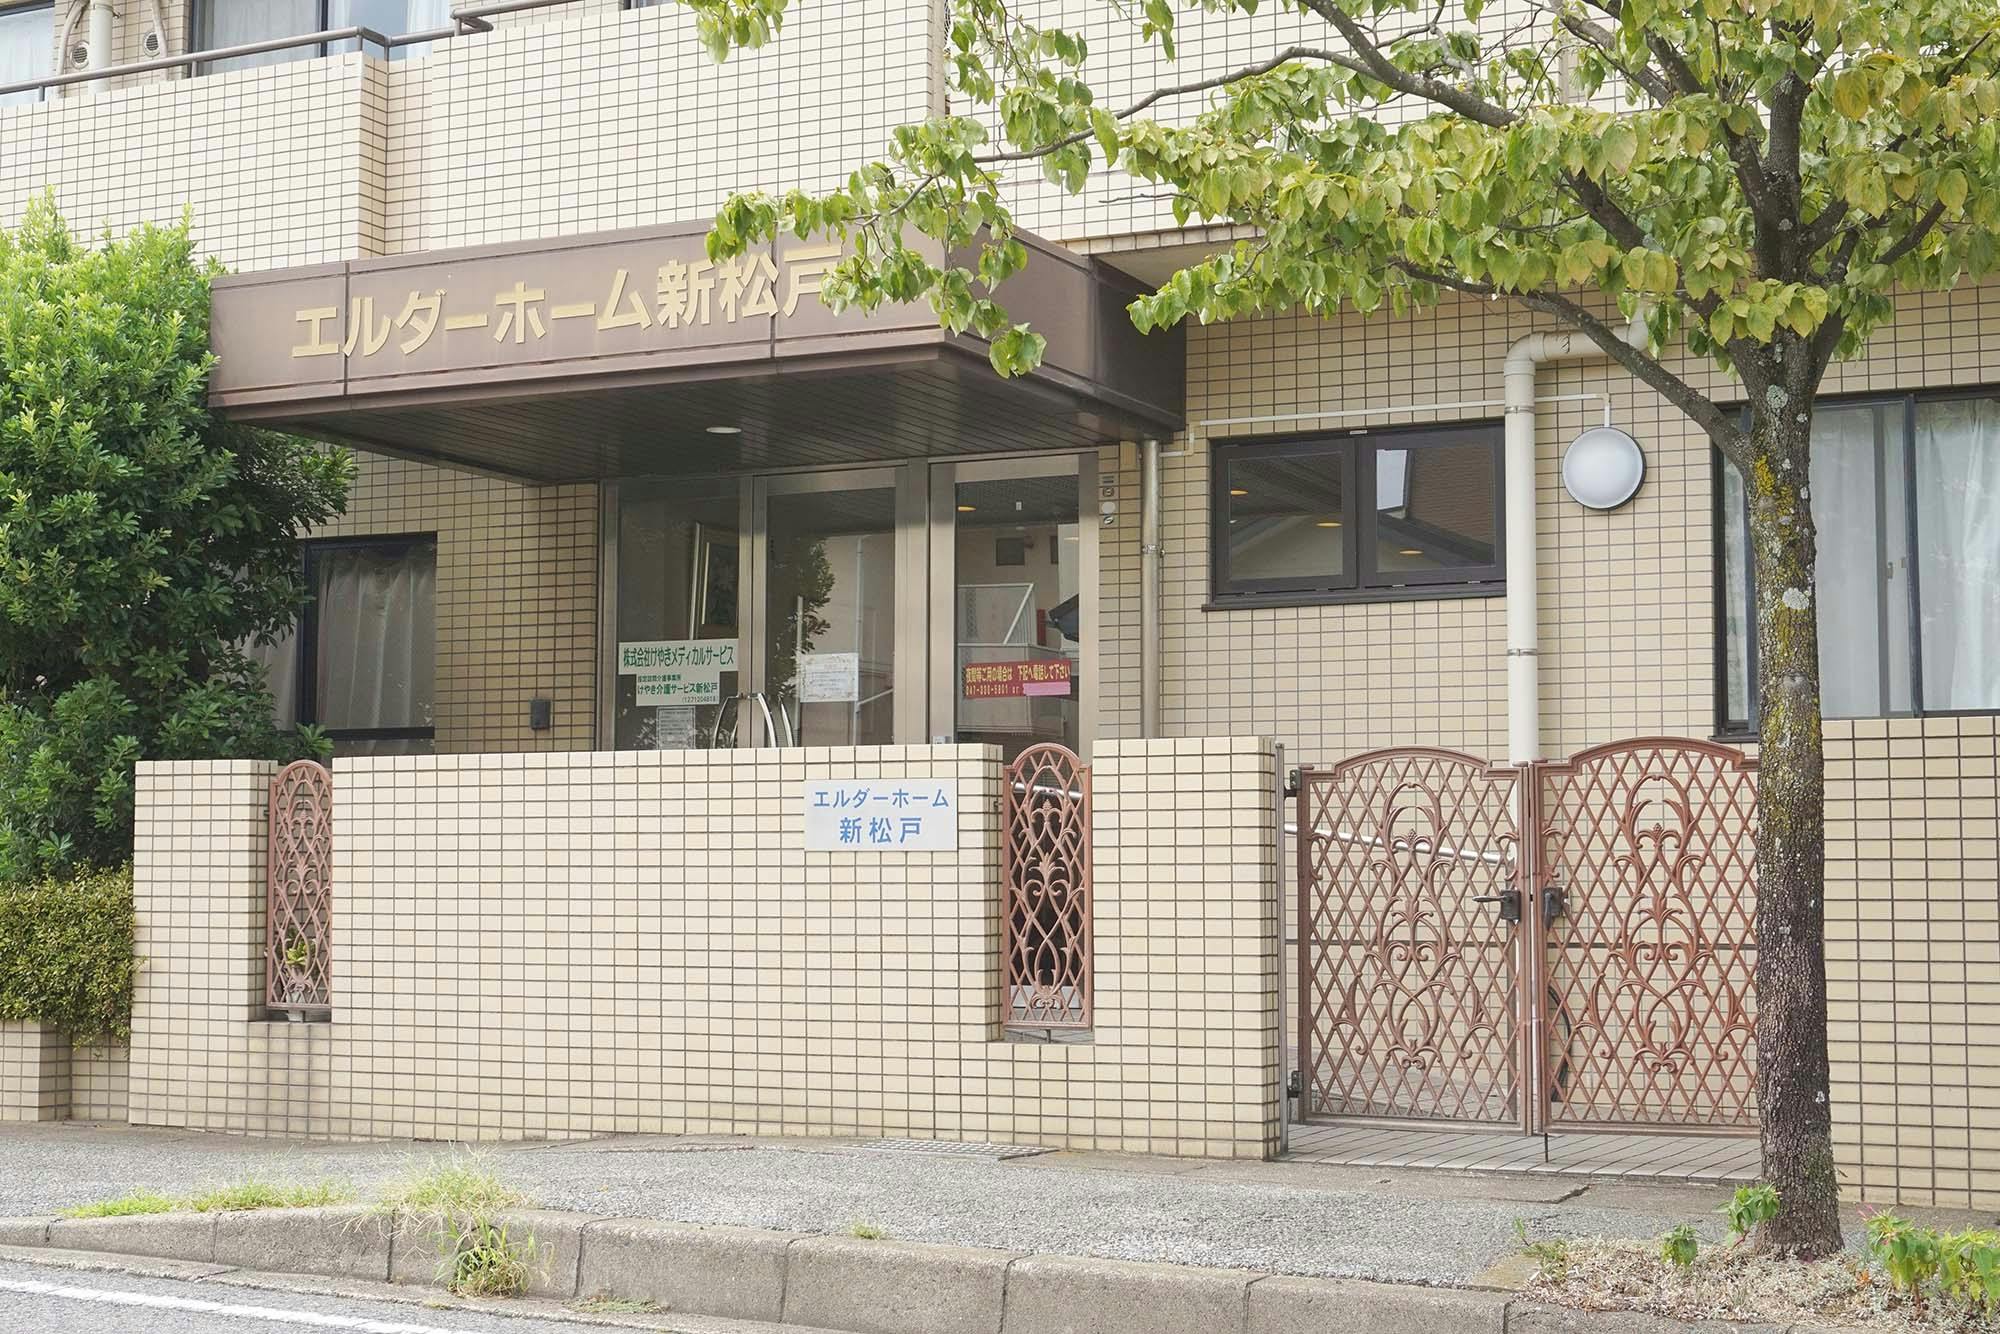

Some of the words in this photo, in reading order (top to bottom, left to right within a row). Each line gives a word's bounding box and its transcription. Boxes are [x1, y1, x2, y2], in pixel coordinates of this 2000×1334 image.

[291, 244, 842, 359] エルダーホーム新松戸
[623, 645, 735, 668] 株式会社けやきメディカルサービス
[637, 682, 719, 696] けやき介護サービス新松戸
[813, 787, 950, 809] エルダーホーム
[839, 816, 922, 844] 新松戸
